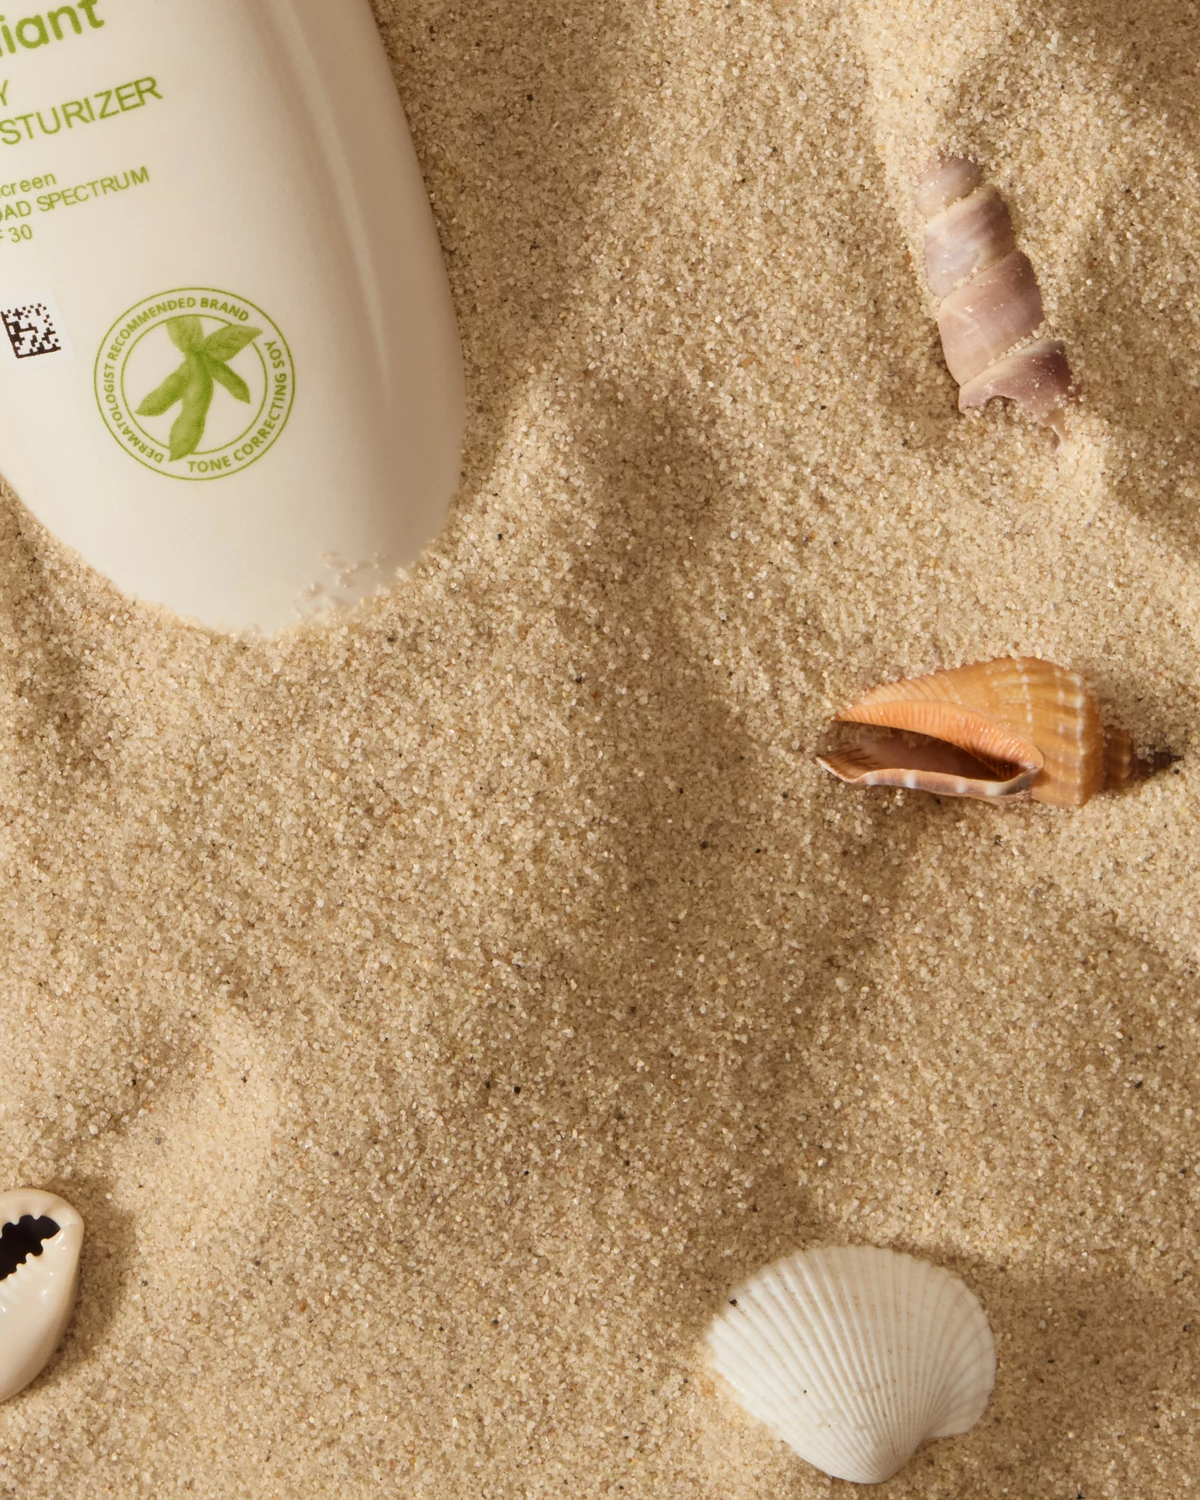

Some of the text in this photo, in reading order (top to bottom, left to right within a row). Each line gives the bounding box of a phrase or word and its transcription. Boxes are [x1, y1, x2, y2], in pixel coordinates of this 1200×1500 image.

[8, 223, 34, 243] 30
[36, 165, 151, 212] SPECTRUM
[103, 296, 250, 465] DERMATOLOGIST RECOMMENDED BRAND
[187, 339, 288, 474] TONE CORRECTING SOY
